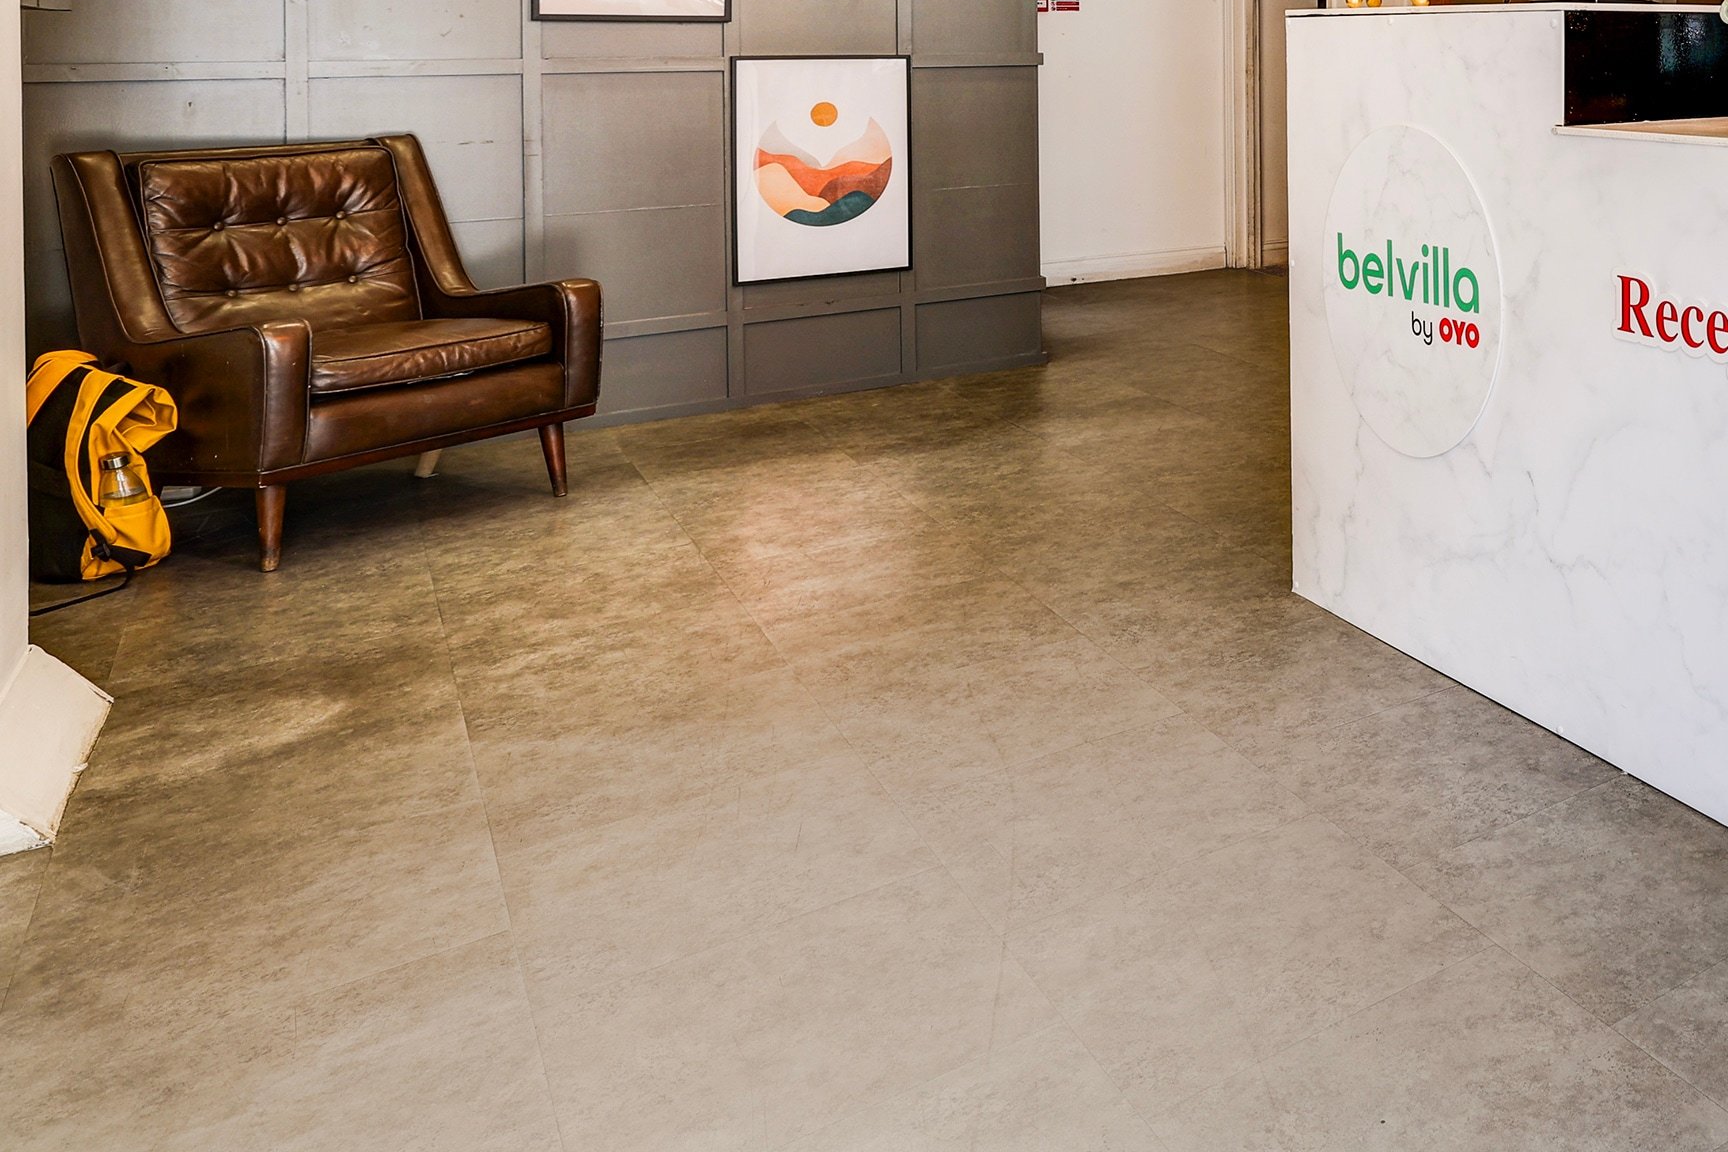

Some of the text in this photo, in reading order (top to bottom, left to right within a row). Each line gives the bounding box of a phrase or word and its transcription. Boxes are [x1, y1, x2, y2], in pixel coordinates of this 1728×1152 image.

[1337, 232, 1480, 314] belvilla
[1411, 311, 1480, 349] by OYO
